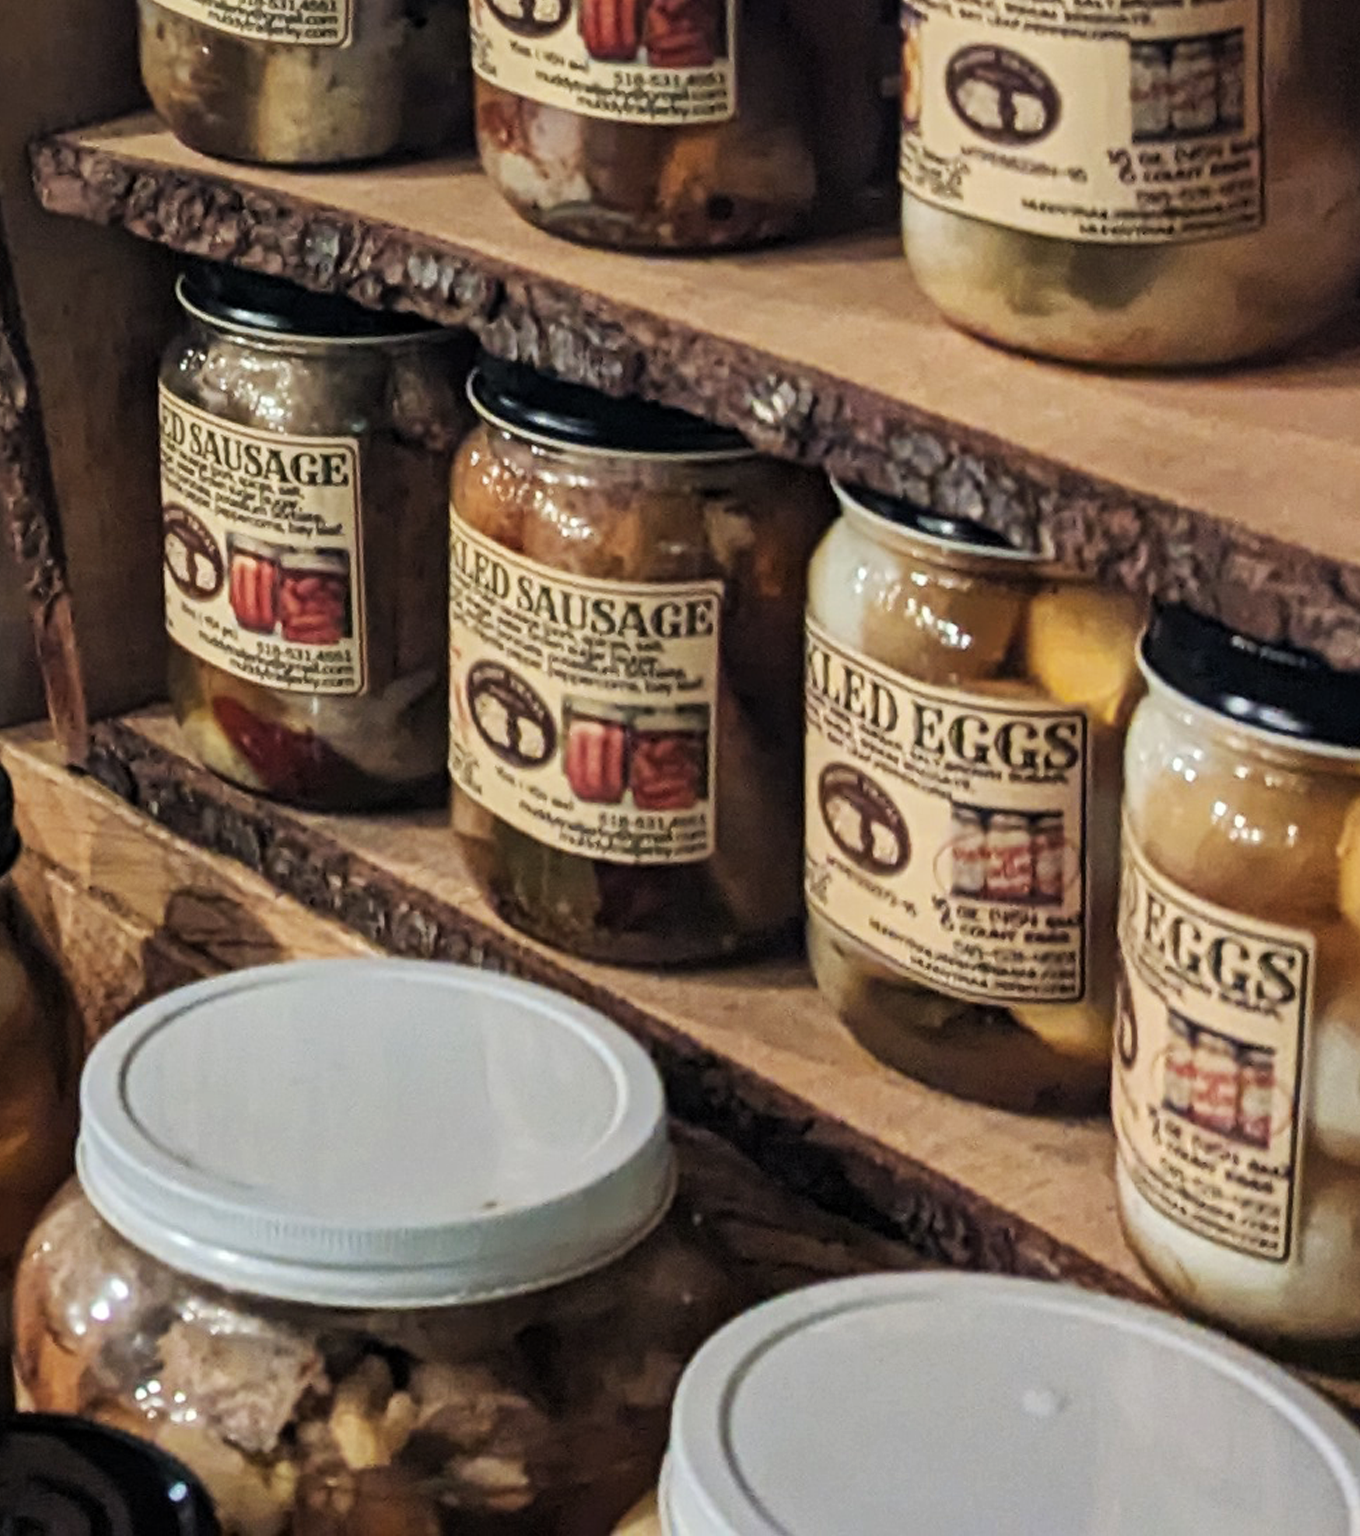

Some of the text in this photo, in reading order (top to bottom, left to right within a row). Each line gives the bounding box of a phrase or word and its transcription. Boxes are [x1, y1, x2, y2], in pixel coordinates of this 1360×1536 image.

[189, 420, 350, 488] SAUSAGE
[515, 572, 715, 639] SAUSAGE
[911, 698, 1080, 770] EGGS
[1143, 891, 1299, 1008] EGGS
